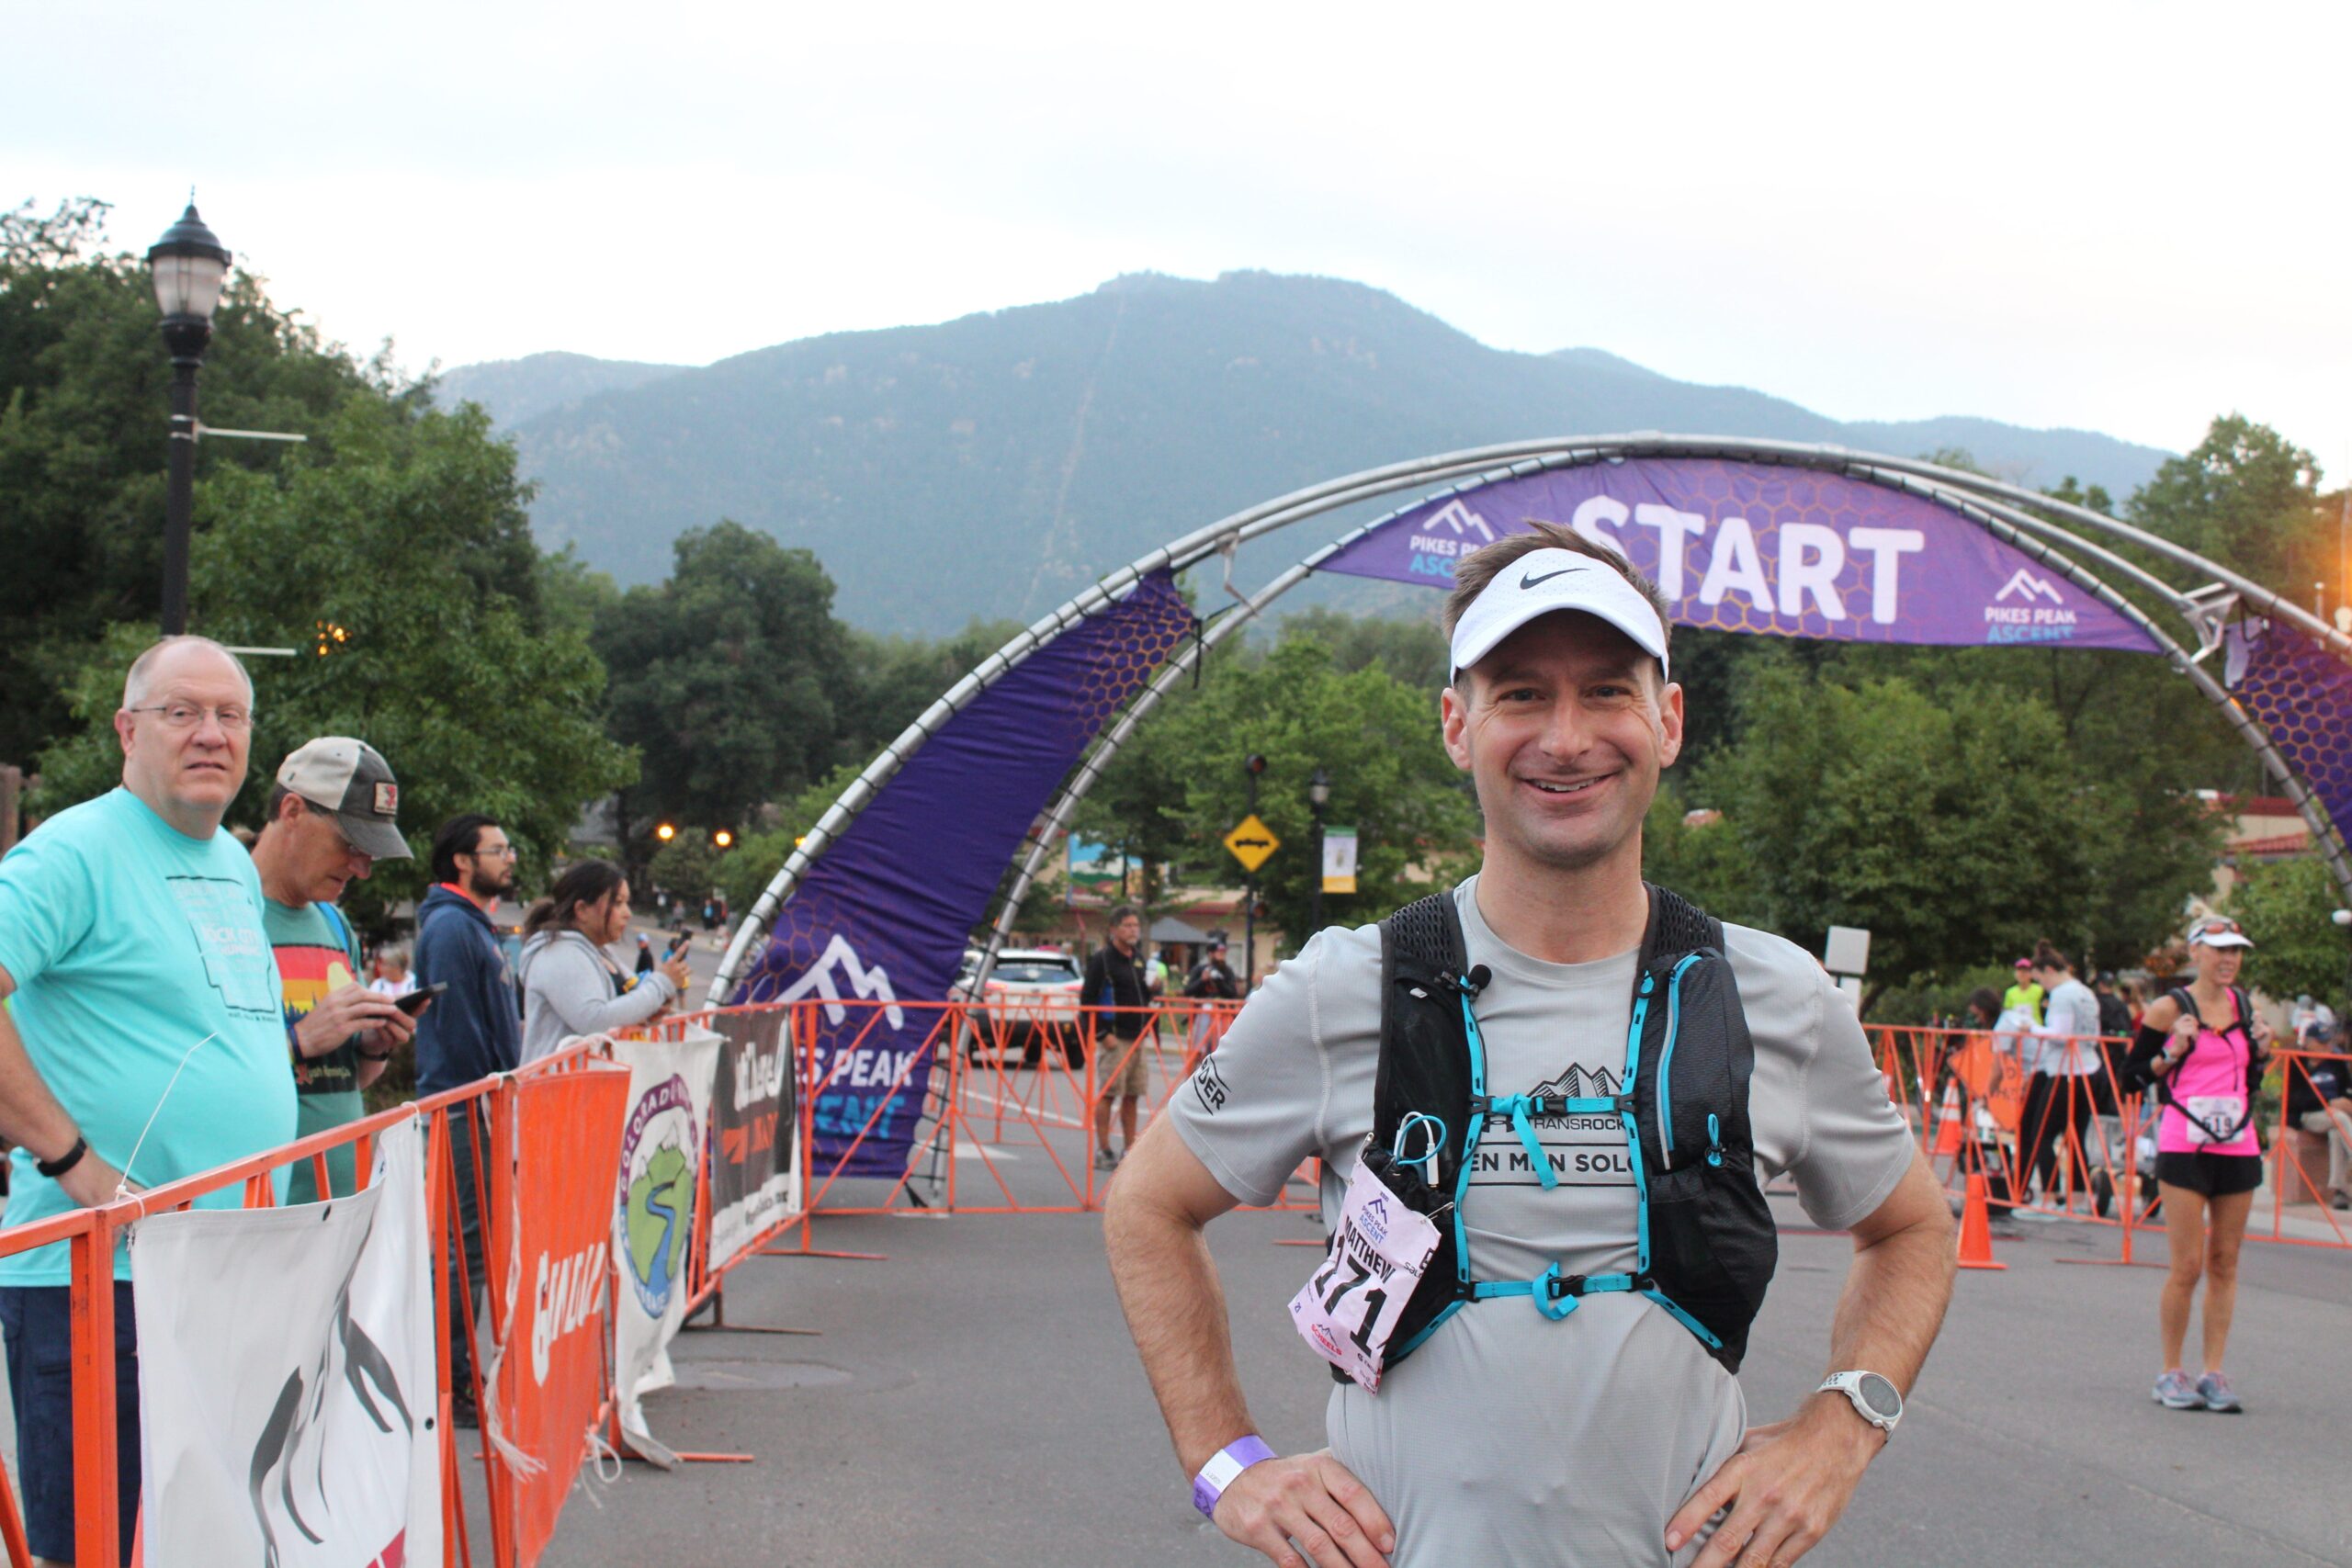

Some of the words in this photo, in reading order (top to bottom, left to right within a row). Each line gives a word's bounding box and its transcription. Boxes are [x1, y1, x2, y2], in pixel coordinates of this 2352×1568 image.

[1409, 535, 1458, 557] PIKES
[1572, 495, 1925, 625] START
[1409, 554, 1457, 578] ASC
[1984, 606, 2031, 625] PIKES
[2033, 607, 2077, 625] PEAK
[1986, 624, 2075, 644] ASCENT
[830, 1049, 919, 1088] PEAK
[813, 1095, 906, 1139] ENT
[1509, 1153, 1566, 1173] MN
[1359, 1214, 1385, 1245] ASCENT
[1362, 1205, 1376, 1224] PIKES
[1344, 1214, 1396, 1284] MATTHEW
[1314, 1234, 1387, 1359] 171
[1310, 1323, 1343, 1357] SCHEELS
